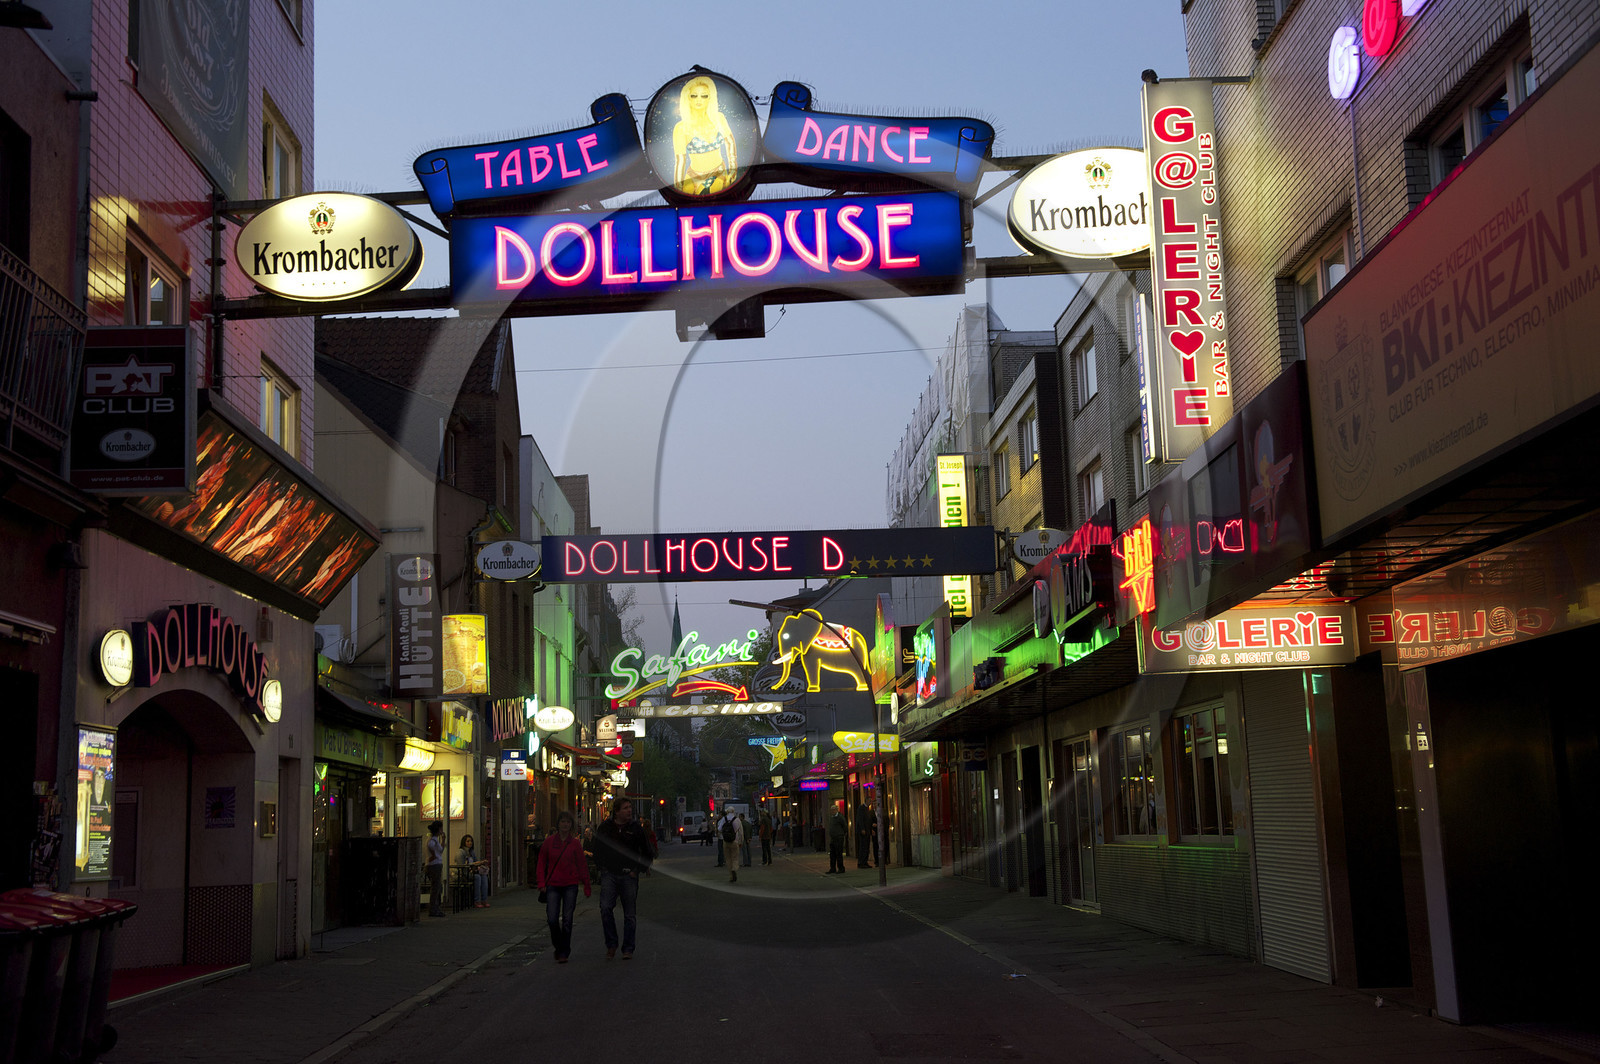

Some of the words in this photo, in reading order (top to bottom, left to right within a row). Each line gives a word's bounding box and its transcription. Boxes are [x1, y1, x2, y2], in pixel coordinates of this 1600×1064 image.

[200, 130, 237, 188] WHISKEY
[475, 133, 608, 189] TABLE
[796, 117, 931, 164] DANCE
[1199, 132, 1219, 205] CLUB
[253, 237, 399, 277] Krombacher
[495, 203, 920, 291] DOLLHOUSE
[1203, 214, 1224, 301] NIGHT
[1379, 263, 1443, 333] BLANKENESE
[1445, 188, 1531, 275] KIEZINTERNAT
[1210, 311, 1226, 331] &
[86, 357, 173, 395] PAT
[1212, 339, 1230, 398] BAR
[1389, 393, 1413, 423] CLUB
[1414, 378, 1435, 406] FÜR
[1436, 348, 1483, 389] TECHNO,
[1485, 305, 1546, 359] ELECTRO,
[82, 398, 176, 414] CLUB
[106, 441, 152, 453] Krombacher
[483, 557, 535, 571] Krombacher
[565, 537, 792, 576] DOLLHOUSE
[822, 536, 844, 571] D
[399, 586, 433, 690] HÜTTE
[400, 608, 410, 633] Pauli
[147, 602, 270, 714] DOLLHOUSE
[400, 634, 410, 662] Sankt
[605, 629, 758, 699] Safari
[1188, 653, 1217, 666] BAR
[1220, 653, 1231, 665] &
[1234, 652, 1275, 664] NIGHT
[1275, 651, 1311, 663] CLUB
[665, 702, 774, 716] CASINO
[776, 713, 804, 725] Colibri
